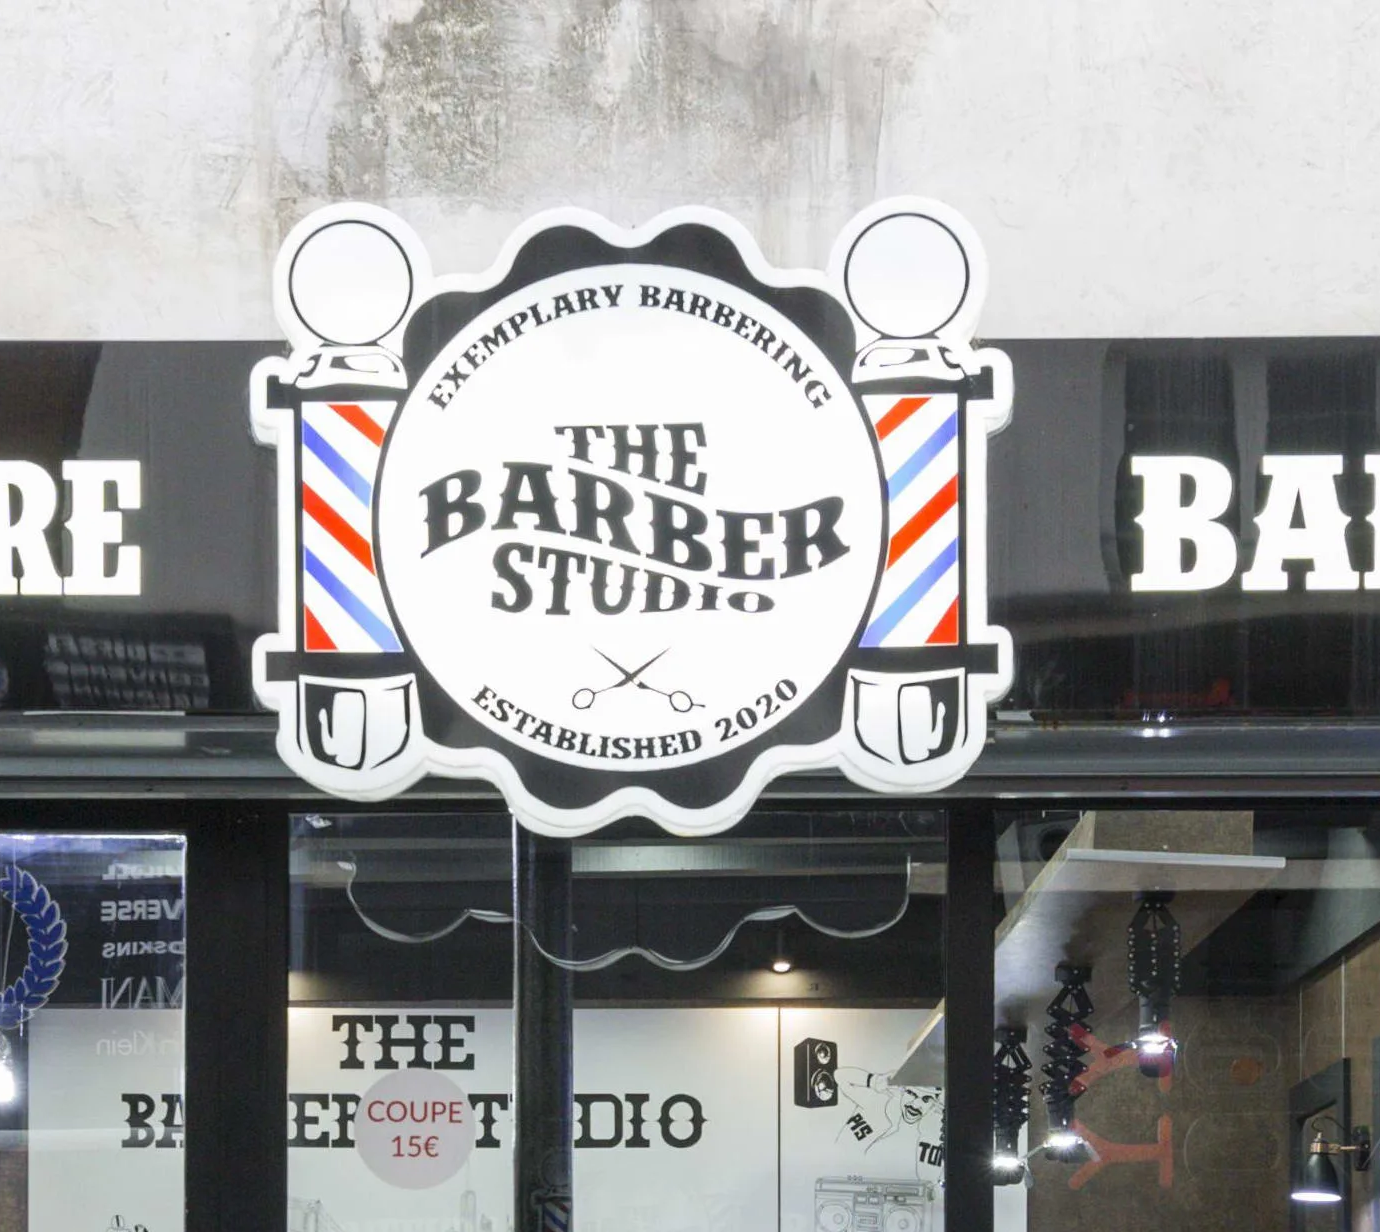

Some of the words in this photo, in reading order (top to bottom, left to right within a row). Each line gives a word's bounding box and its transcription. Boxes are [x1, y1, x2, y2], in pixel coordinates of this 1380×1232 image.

[427, 283, 625, 412] EXEMPLARY
[638, 283, 833, 410] BARBERING
[554, 420, 709, 496] THE
[418, 460, 851, 580] BARBER
[490, 541, 776, 616] STUDIO
[472, 684, 702, 760] ESTABLISHED
[714, 678, 800, 743] 2020
[331, 1014, 476, 1070] THE
[366, 1099, 463, 1125] COUPE
[391, 1136, 440, 1160] 15€
